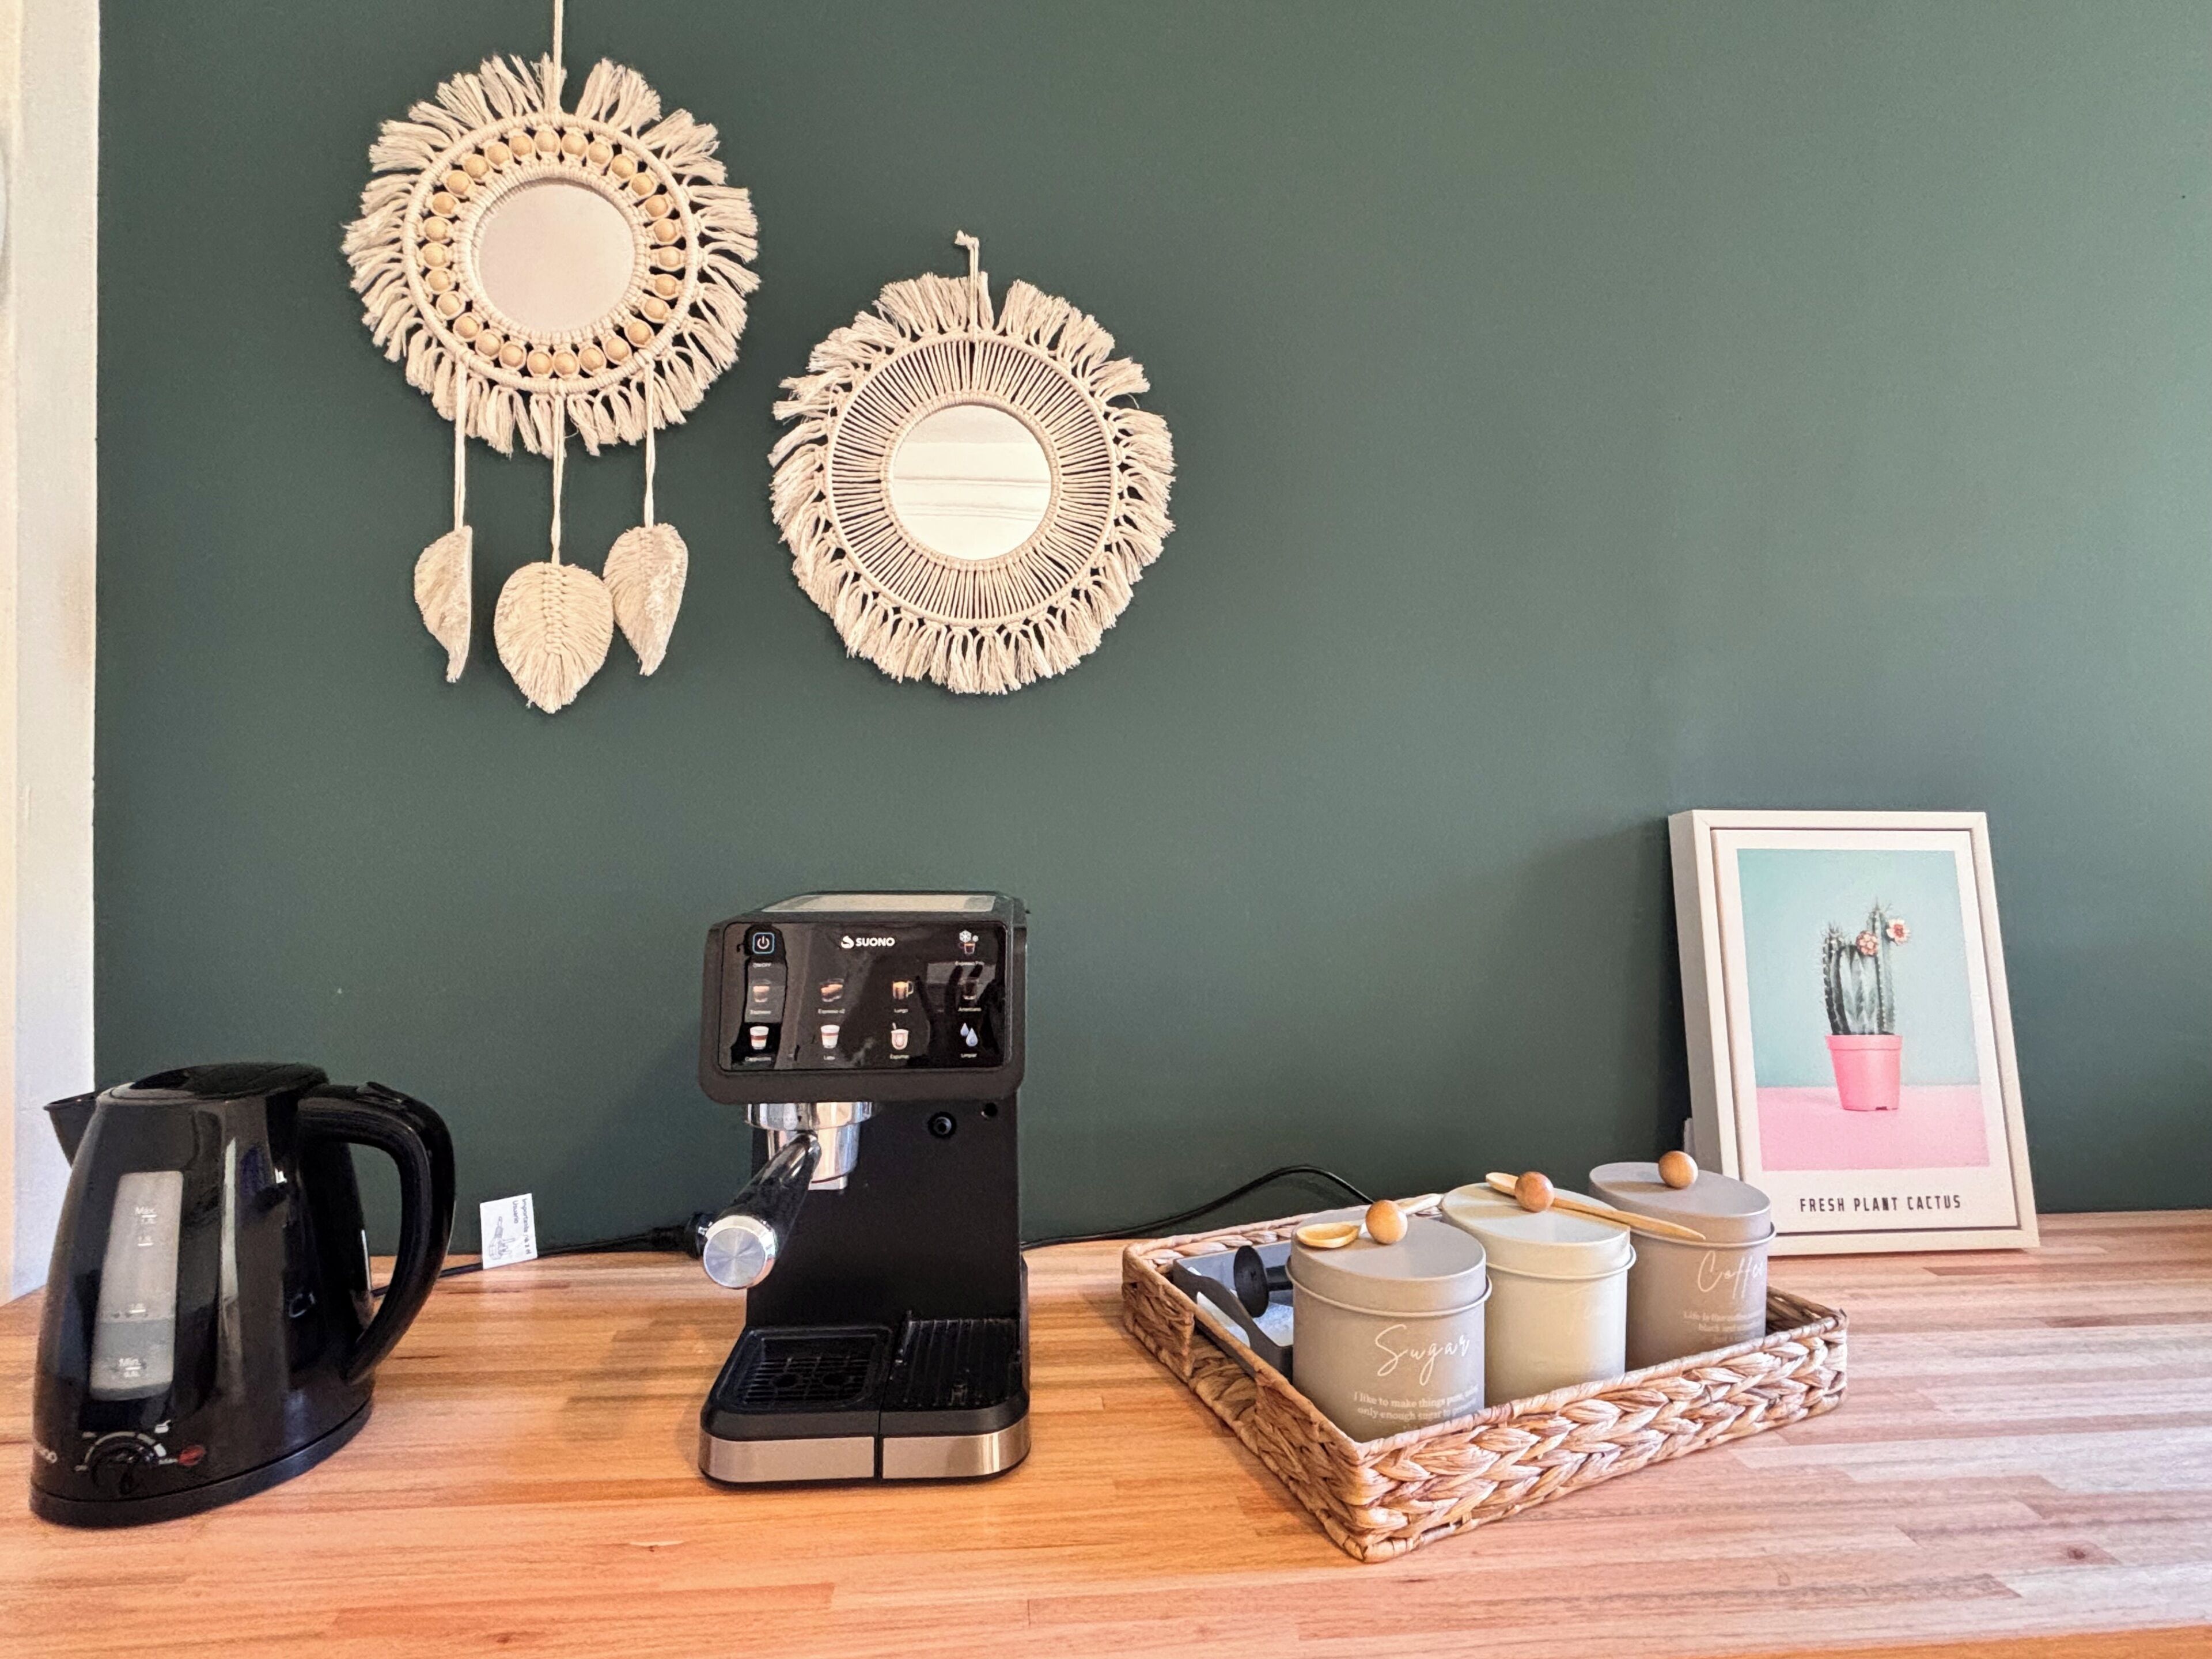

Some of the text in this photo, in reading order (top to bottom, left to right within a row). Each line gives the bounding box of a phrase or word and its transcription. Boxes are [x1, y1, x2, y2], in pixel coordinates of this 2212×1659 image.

[855, 937, 895, 947] SUONO
[1800, 1195, 1961, 1212] FRESH PLANT CACTUS
[1375, 1324, 1469, 1386] Sugar
[1354, 1391, 1358, 1402] I
[1359, 1392, 1377, 1405] like
[1378, 1397, 1389, 1407] to
[1391, 1399, 1417, 1408] make
[1419, 1397, 1446, 1409] things
[1357, 1407, 1378, 1419] only
[1380, 1410, 1416, 1423] enough
[1418, 1411, 1442, 1422] sugar
